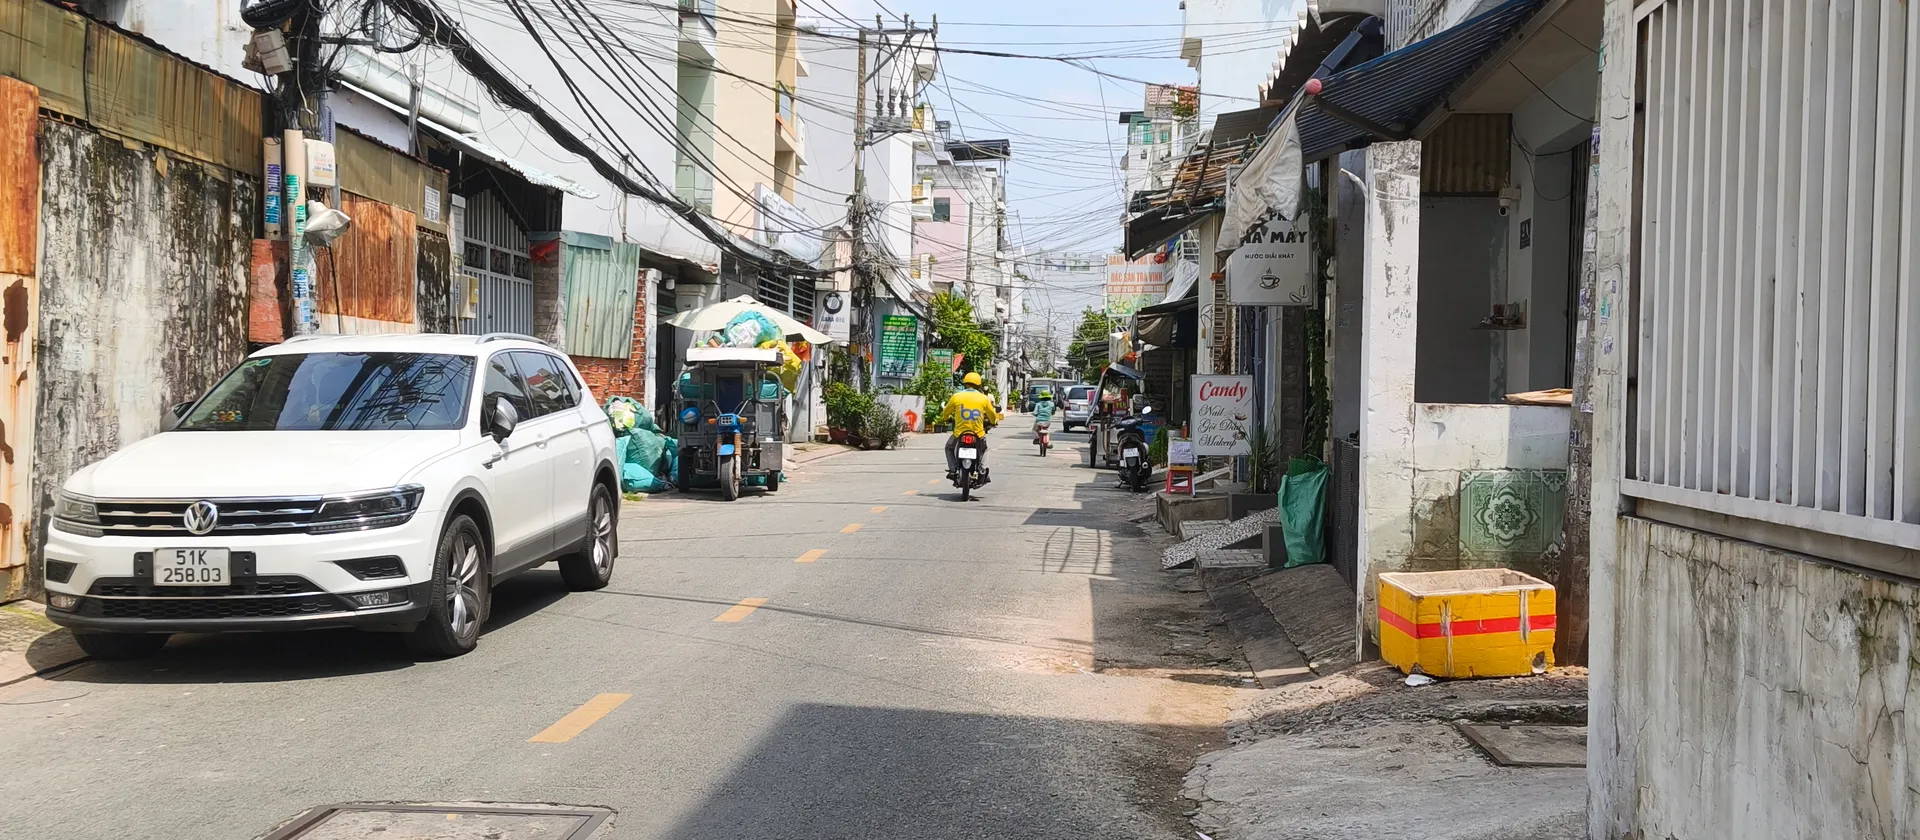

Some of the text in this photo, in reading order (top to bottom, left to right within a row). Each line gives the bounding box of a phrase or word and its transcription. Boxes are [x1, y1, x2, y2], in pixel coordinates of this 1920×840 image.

[1270, 228, 1308, 244] MÁY
[1199, 380, 1248, 402] Candy
[960, 404, 981, 421] be
[1198, 404, 1225, 417] Nail
[1198, 434, 1237, 450] Makeup
[176, 550, 207, 565] 51K
[163, 568, 221, 582] 258.03
